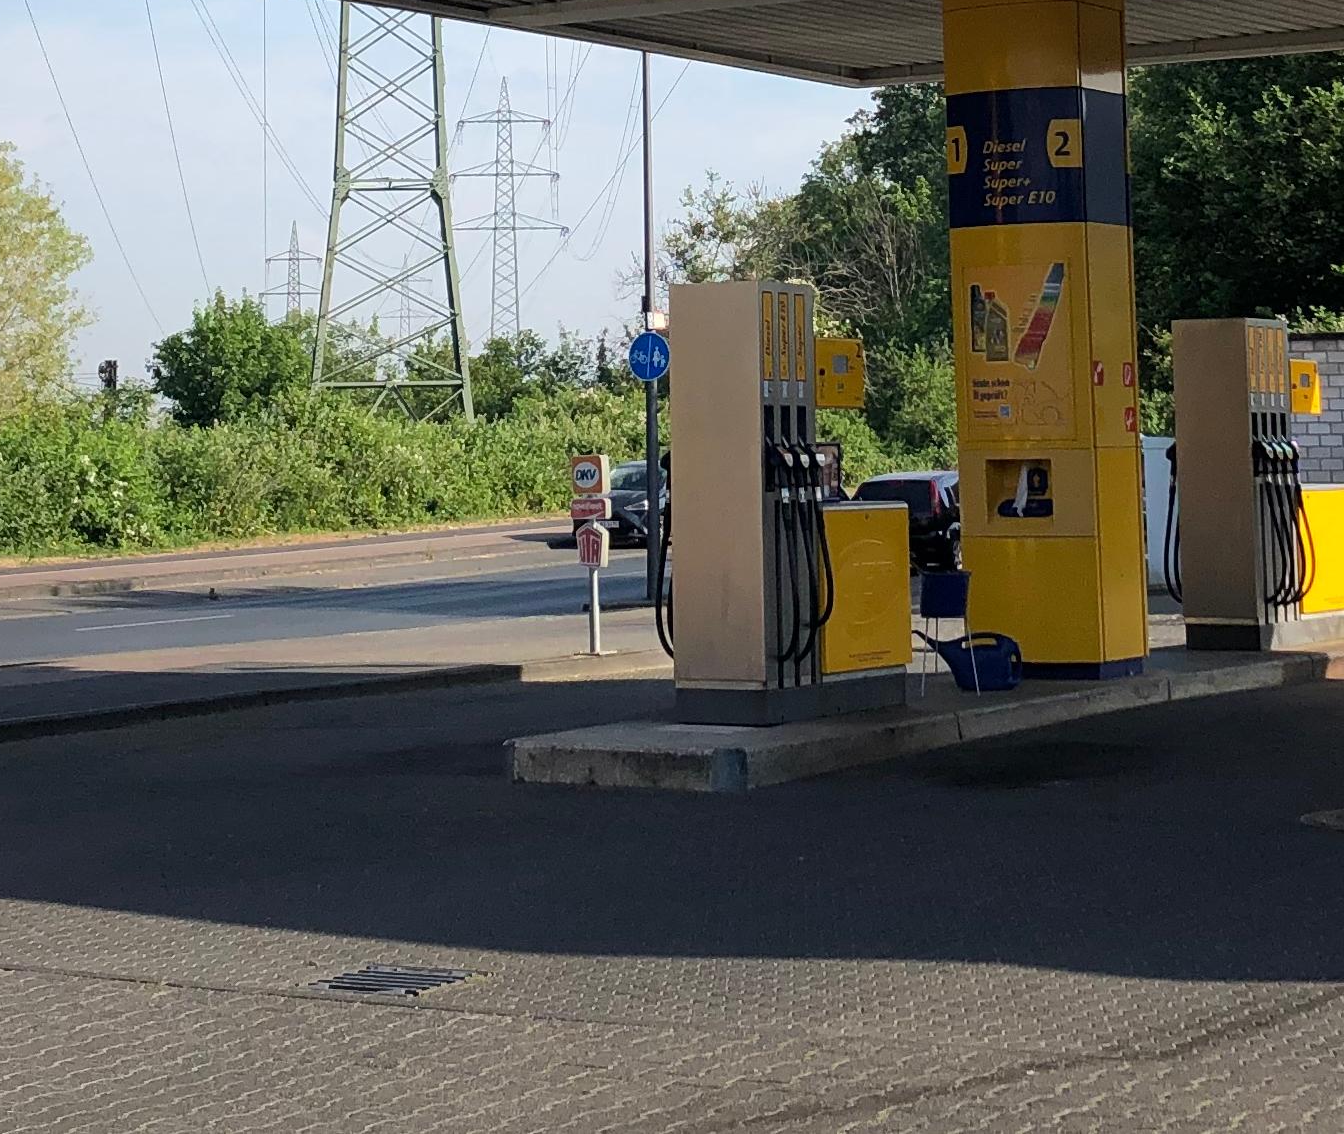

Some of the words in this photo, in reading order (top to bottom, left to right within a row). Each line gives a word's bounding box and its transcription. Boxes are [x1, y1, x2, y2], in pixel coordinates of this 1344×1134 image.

[951, 137, 960, 163] 1
[982, 138, 1026, 155] Diesel
[1054, 131, 1071, 157] 2
[983, 158, 1023, 173] Super
[983, 175, 1031, 191] Super+
[984, 193, 1024, 209] Super
[1028, 190, 1056, 205] E10
[575, 468, 597, 481] DKV
